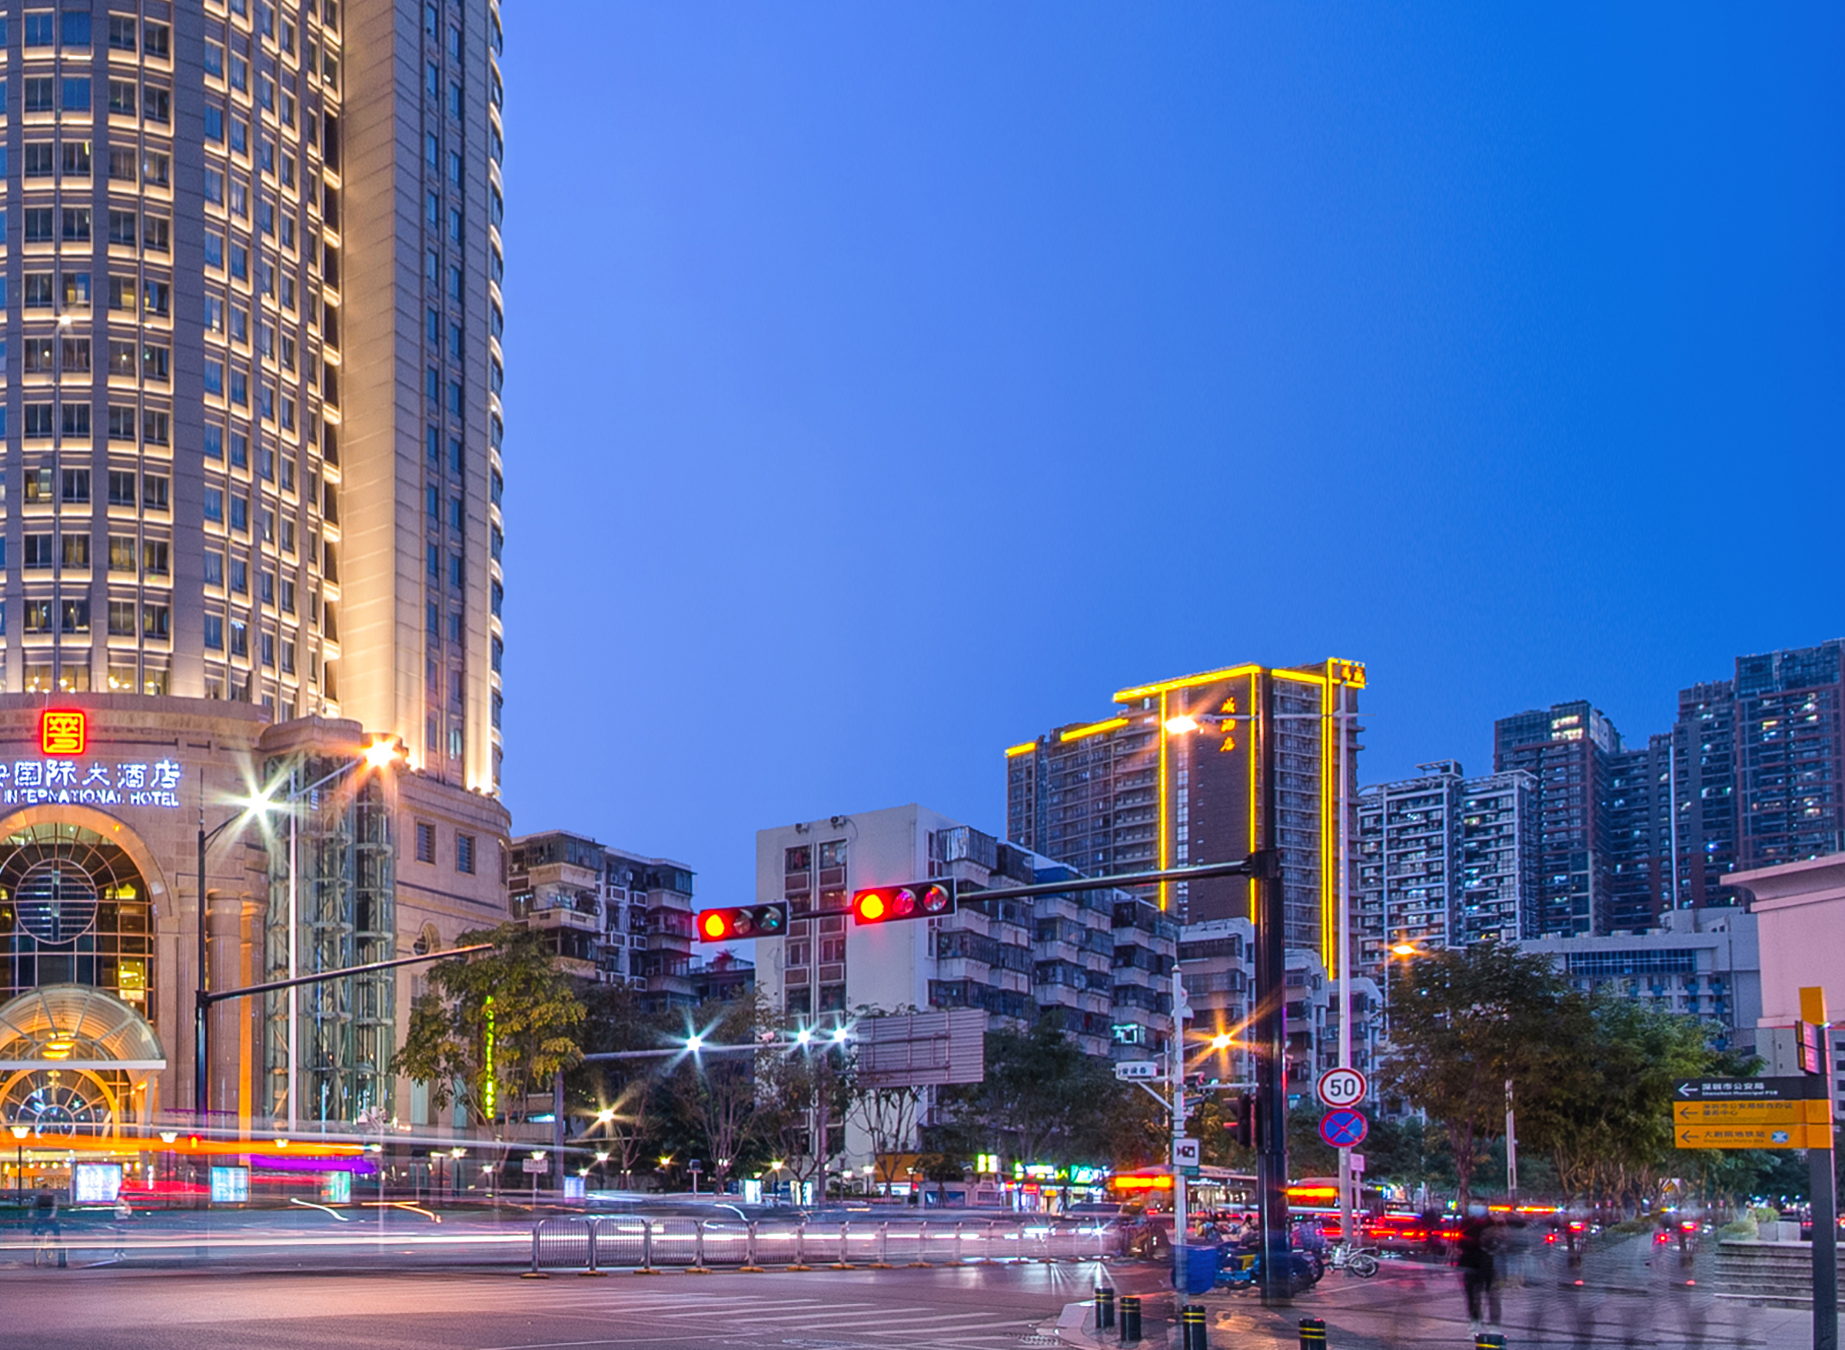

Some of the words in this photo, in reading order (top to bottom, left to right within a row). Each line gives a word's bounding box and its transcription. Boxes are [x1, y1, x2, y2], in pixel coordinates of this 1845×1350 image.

[4, 787, 125, 806] INTERNATIONAL
[130, 790, 180, 807] HOTEL
[1330, 1078, 1355, 1097] 50
